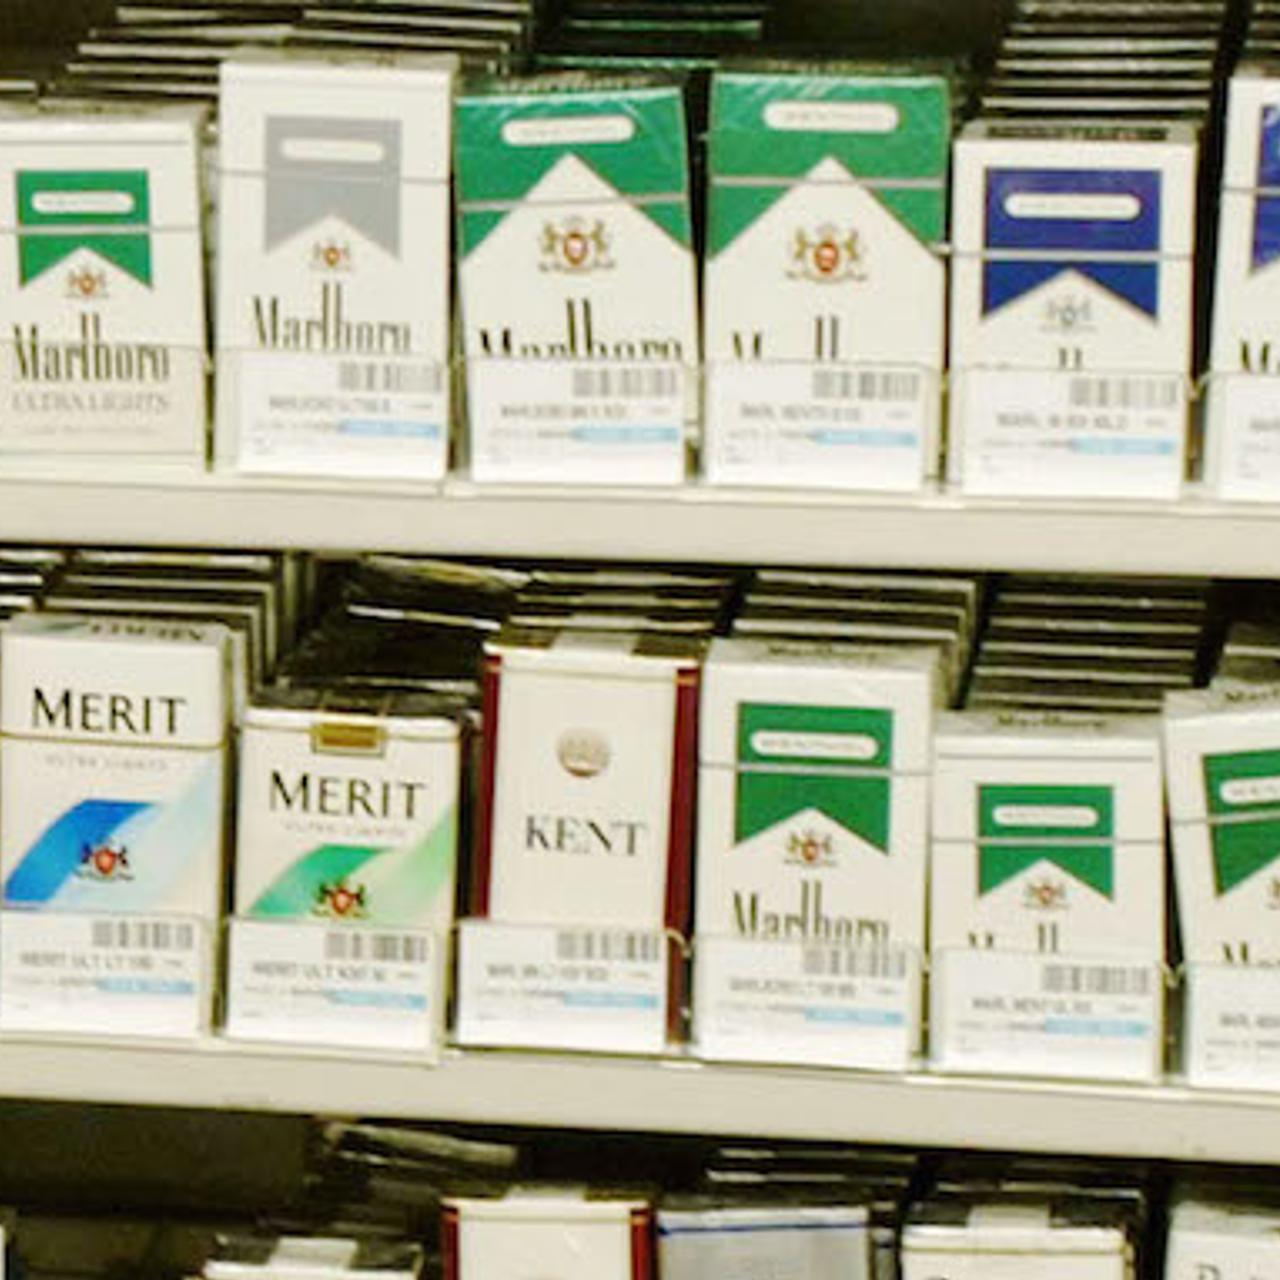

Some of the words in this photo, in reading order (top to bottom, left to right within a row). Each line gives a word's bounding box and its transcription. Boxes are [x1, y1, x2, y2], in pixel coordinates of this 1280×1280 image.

[253, 282, 410, 351] Marlboro
[12, 312, 170, 382] Marlboro
[31, 687, 185, 734] MERIT
[268, 771, 425, 819] MERIT
[525, 815, 645, 857] KENT
